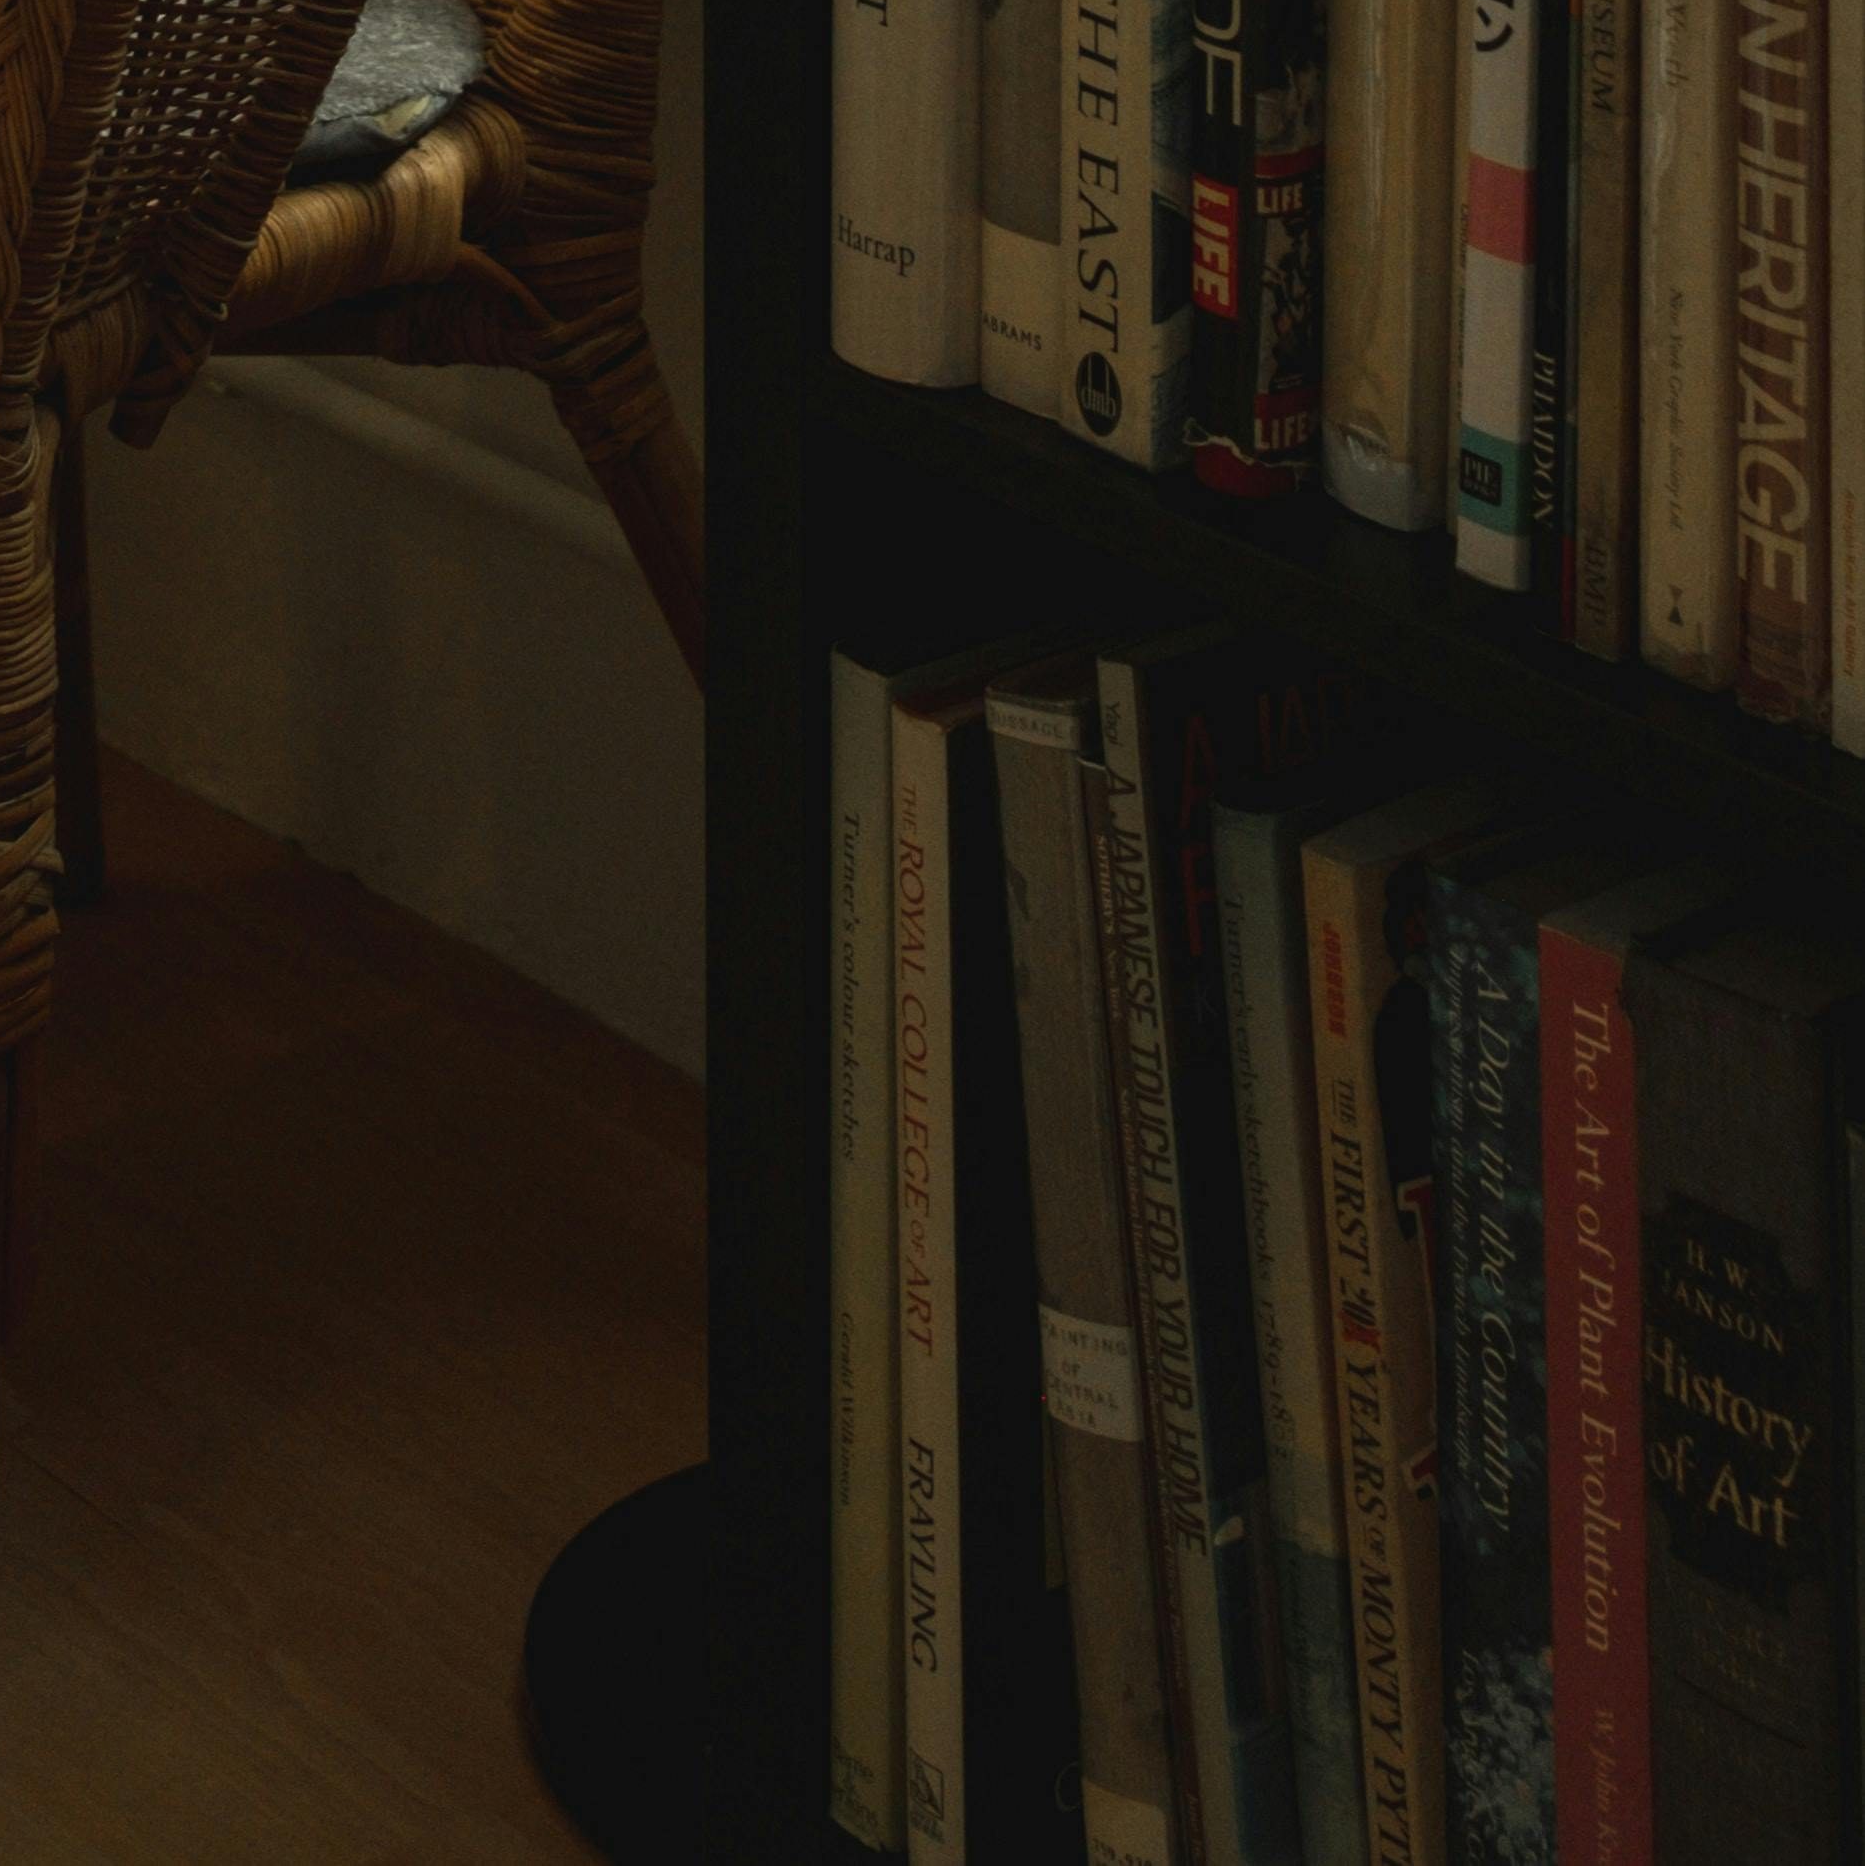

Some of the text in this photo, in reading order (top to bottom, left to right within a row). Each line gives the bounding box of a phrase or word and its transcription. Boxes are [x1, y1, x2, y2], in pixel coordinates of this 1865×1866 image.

[837, 215, 915, 274] Harrap
[1076, 147, 1119, 354] EAST
[1193, 174, 1234, 319] LIFE
[1738, 95, 1811, 606] HERITAGE
[1572, 1002, 1622, 1653] The Art of Plant Evolution
[1647, 1324, 1813, 1489] History
[1649, 1437, 1799, 1548] of Art
